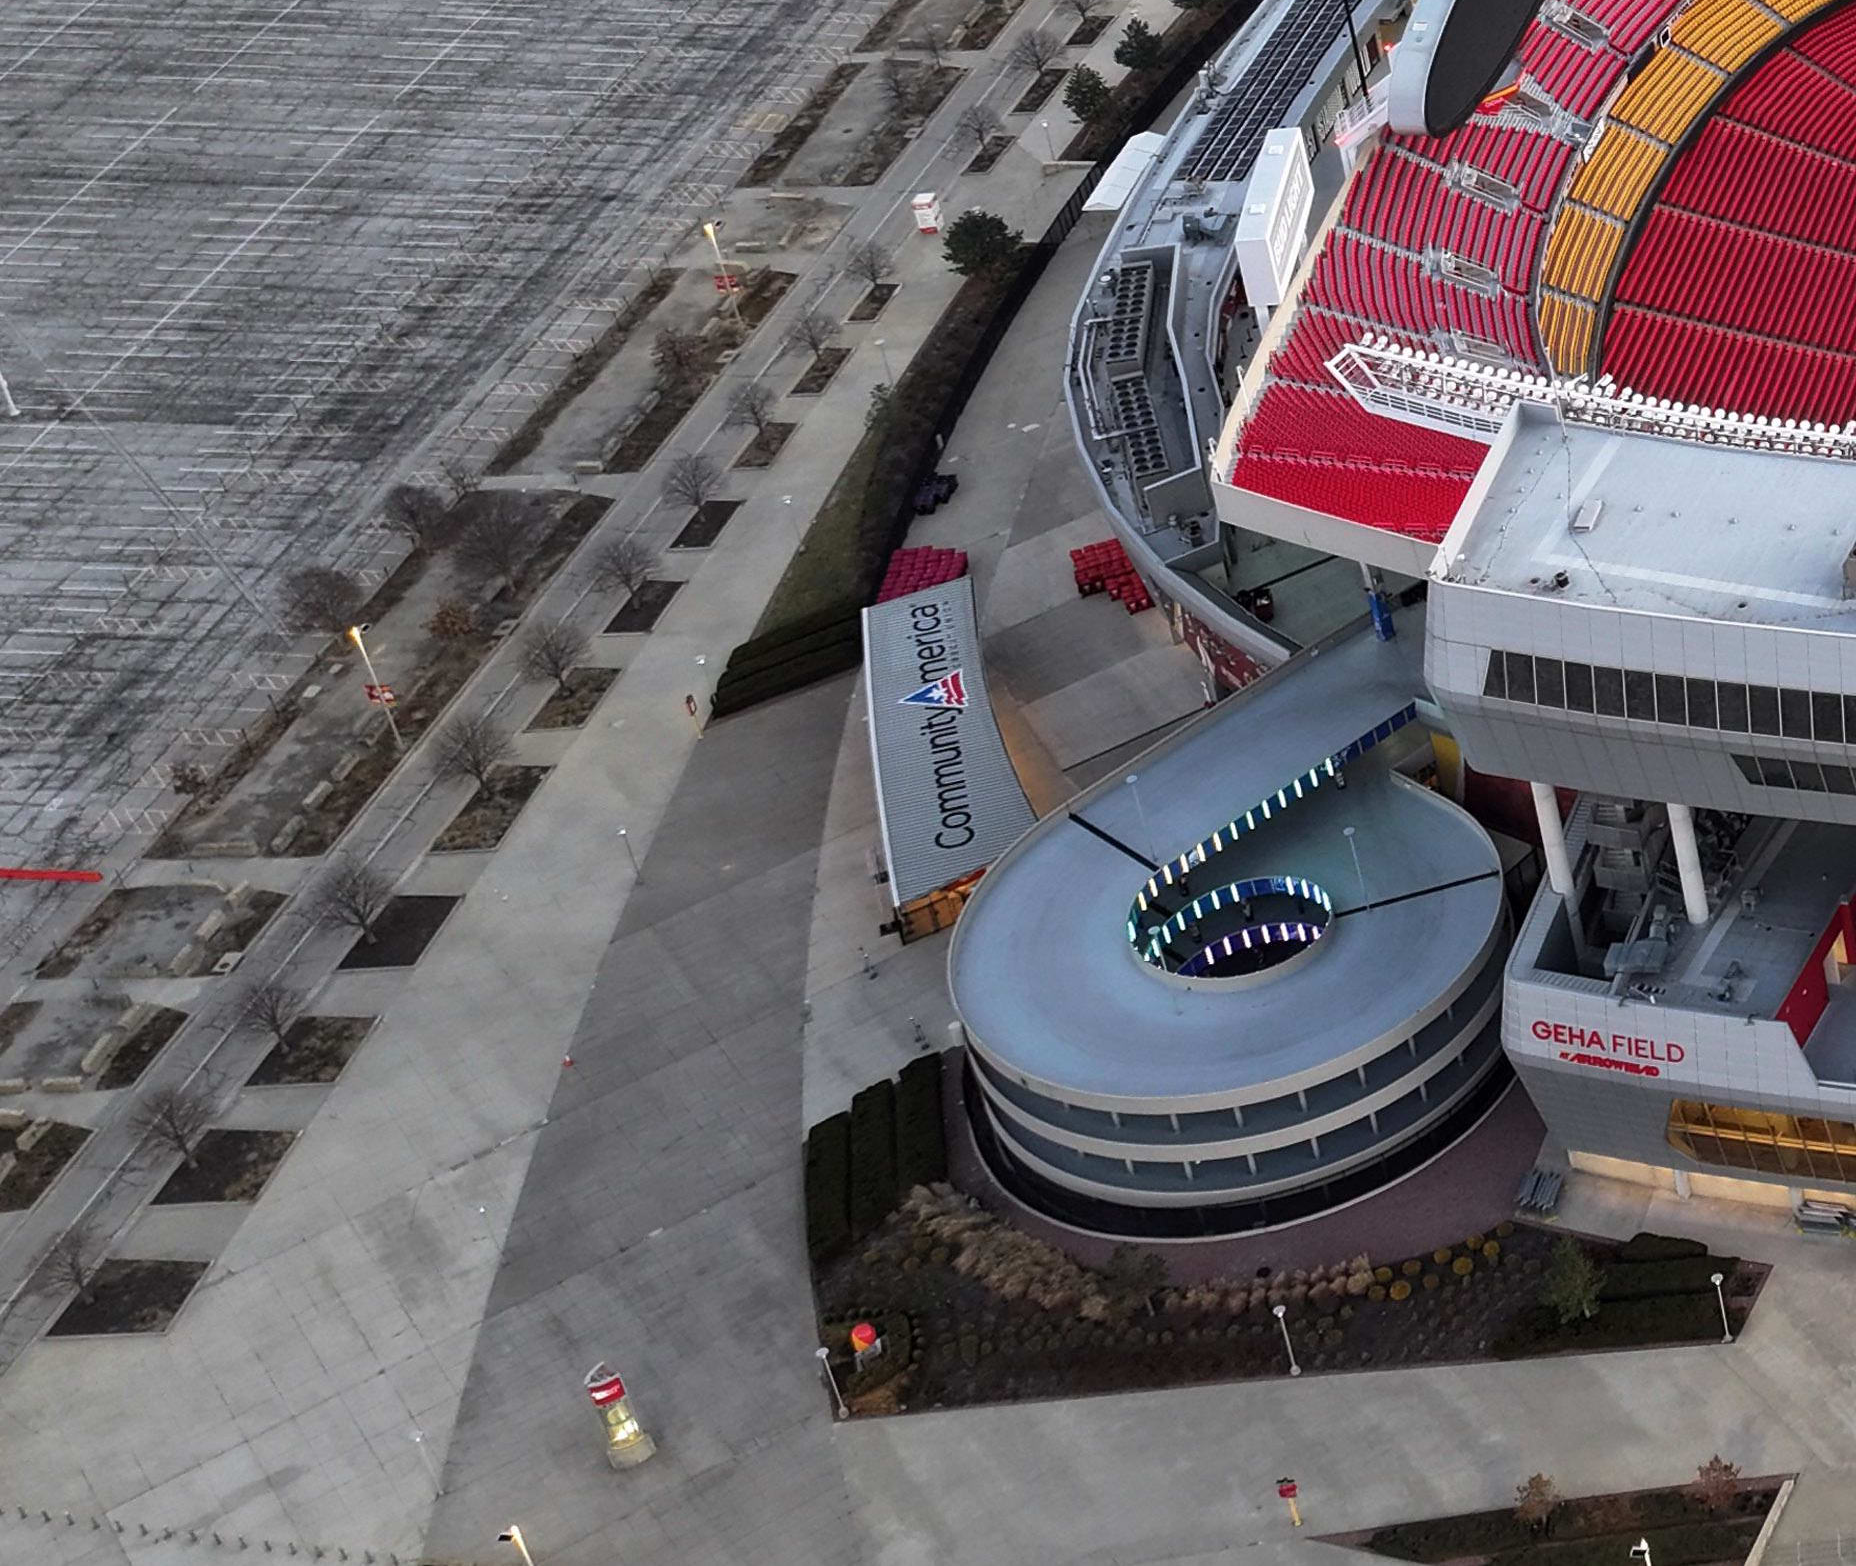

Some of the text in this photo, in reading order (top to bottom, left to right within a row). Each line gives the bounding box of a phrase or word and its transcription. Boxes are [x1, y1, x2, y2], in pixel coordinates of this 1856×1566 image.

[1531, 1020, 1685, 1063] GEHA FIELD
[1569, 1052, 1660, 1077] ARROWHEAD
